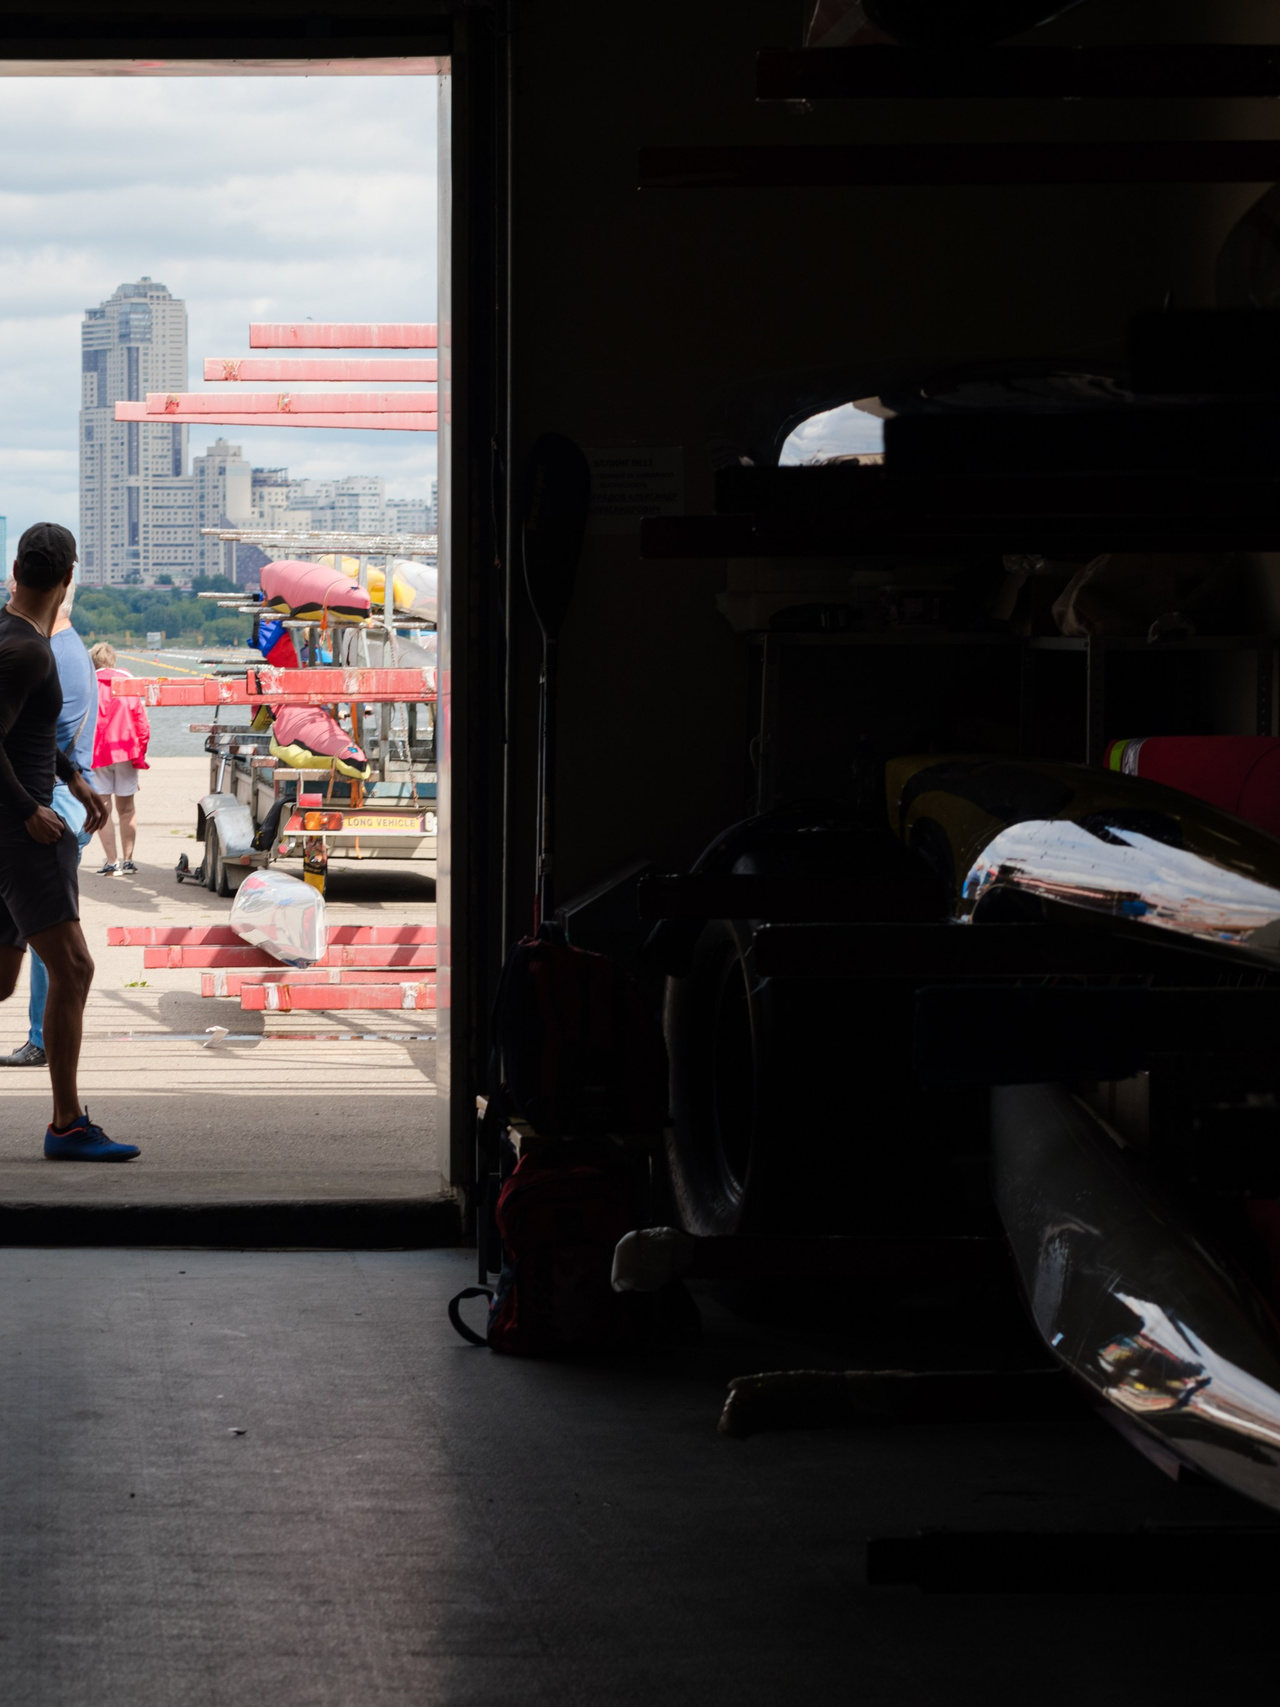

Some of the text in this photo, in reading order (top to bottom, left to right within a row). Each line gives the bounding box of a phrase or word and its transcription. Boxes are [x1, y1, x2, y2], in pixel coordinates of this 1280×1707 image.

[593, 458, 653, 467] ЭЛЛИНГ №11
[628, 492, 679, 501] АЛЕКСАНДР
[347, 818, 415, 827] LONG VEHICLE
